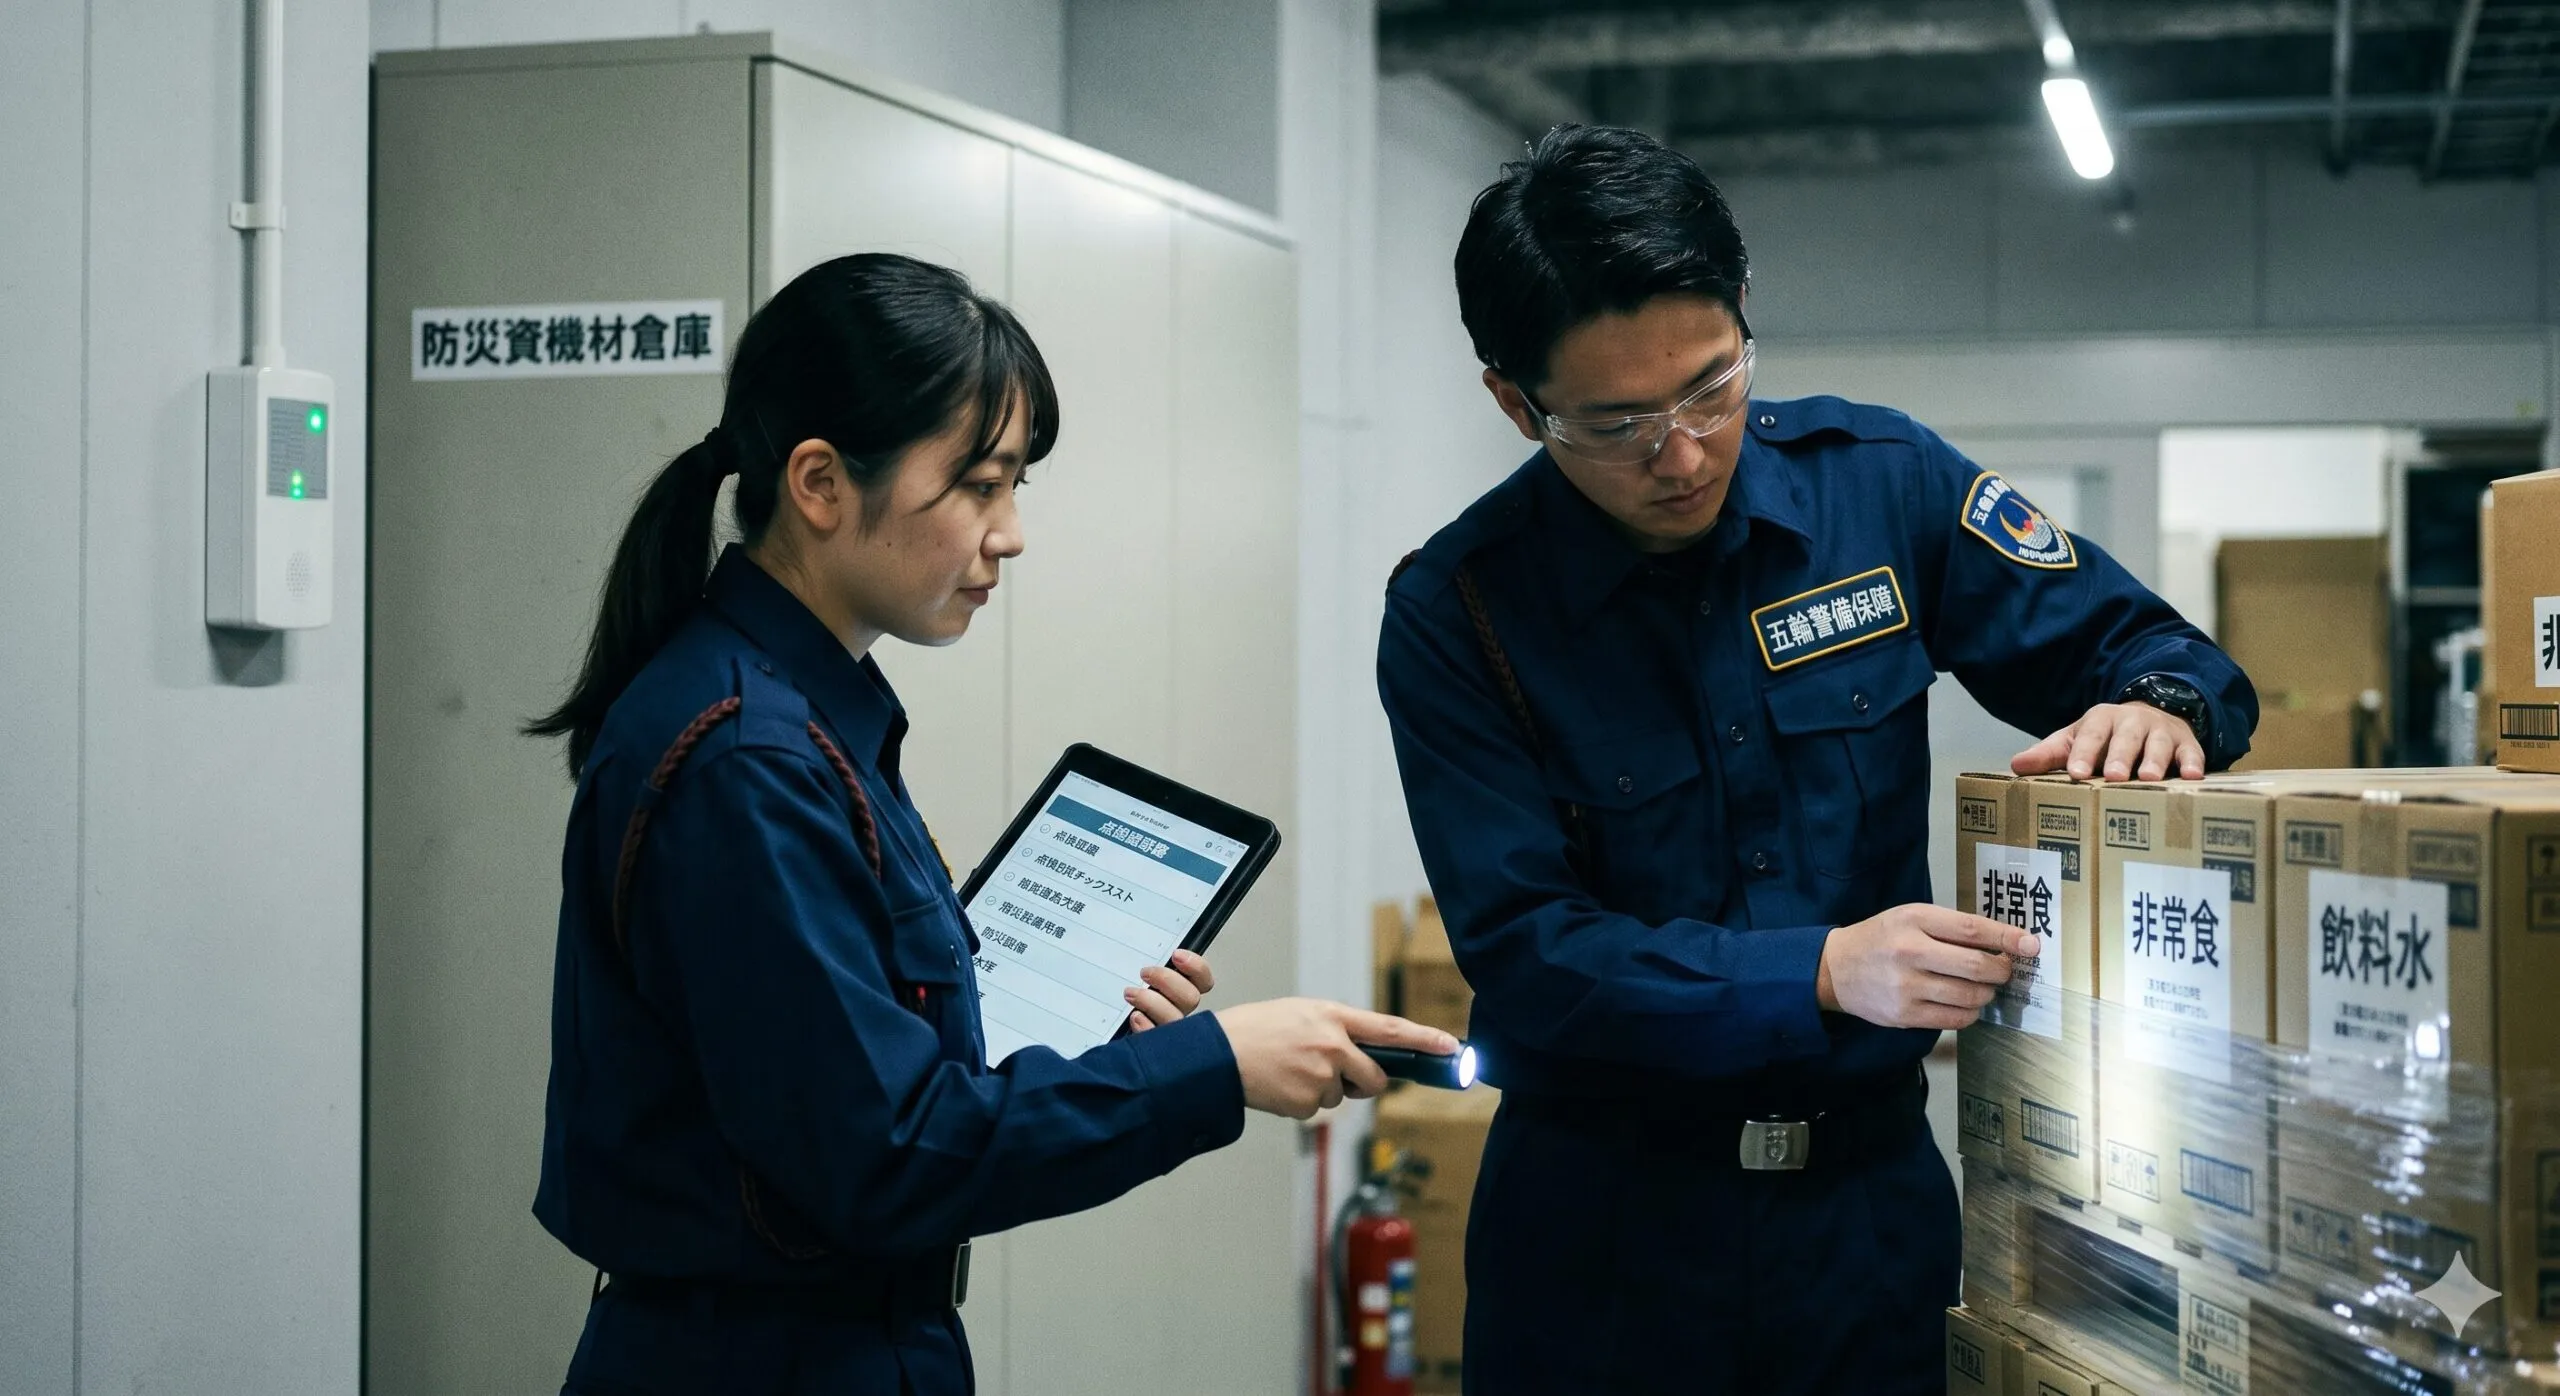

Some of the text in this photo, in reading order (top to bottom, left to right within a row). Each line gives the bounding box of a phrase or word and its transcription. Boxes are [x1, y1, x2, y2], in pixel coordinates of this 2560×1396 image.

[421, 313, 712, 368] 防災資機材倉庫
[1766, 584, 1896, 655] 五輪警備保障
[1983, 869, 2053, 938] 非常食
[2132, 891, 2220, 969] 非常食
[2321, 904, 2434, 990] 飲料水
